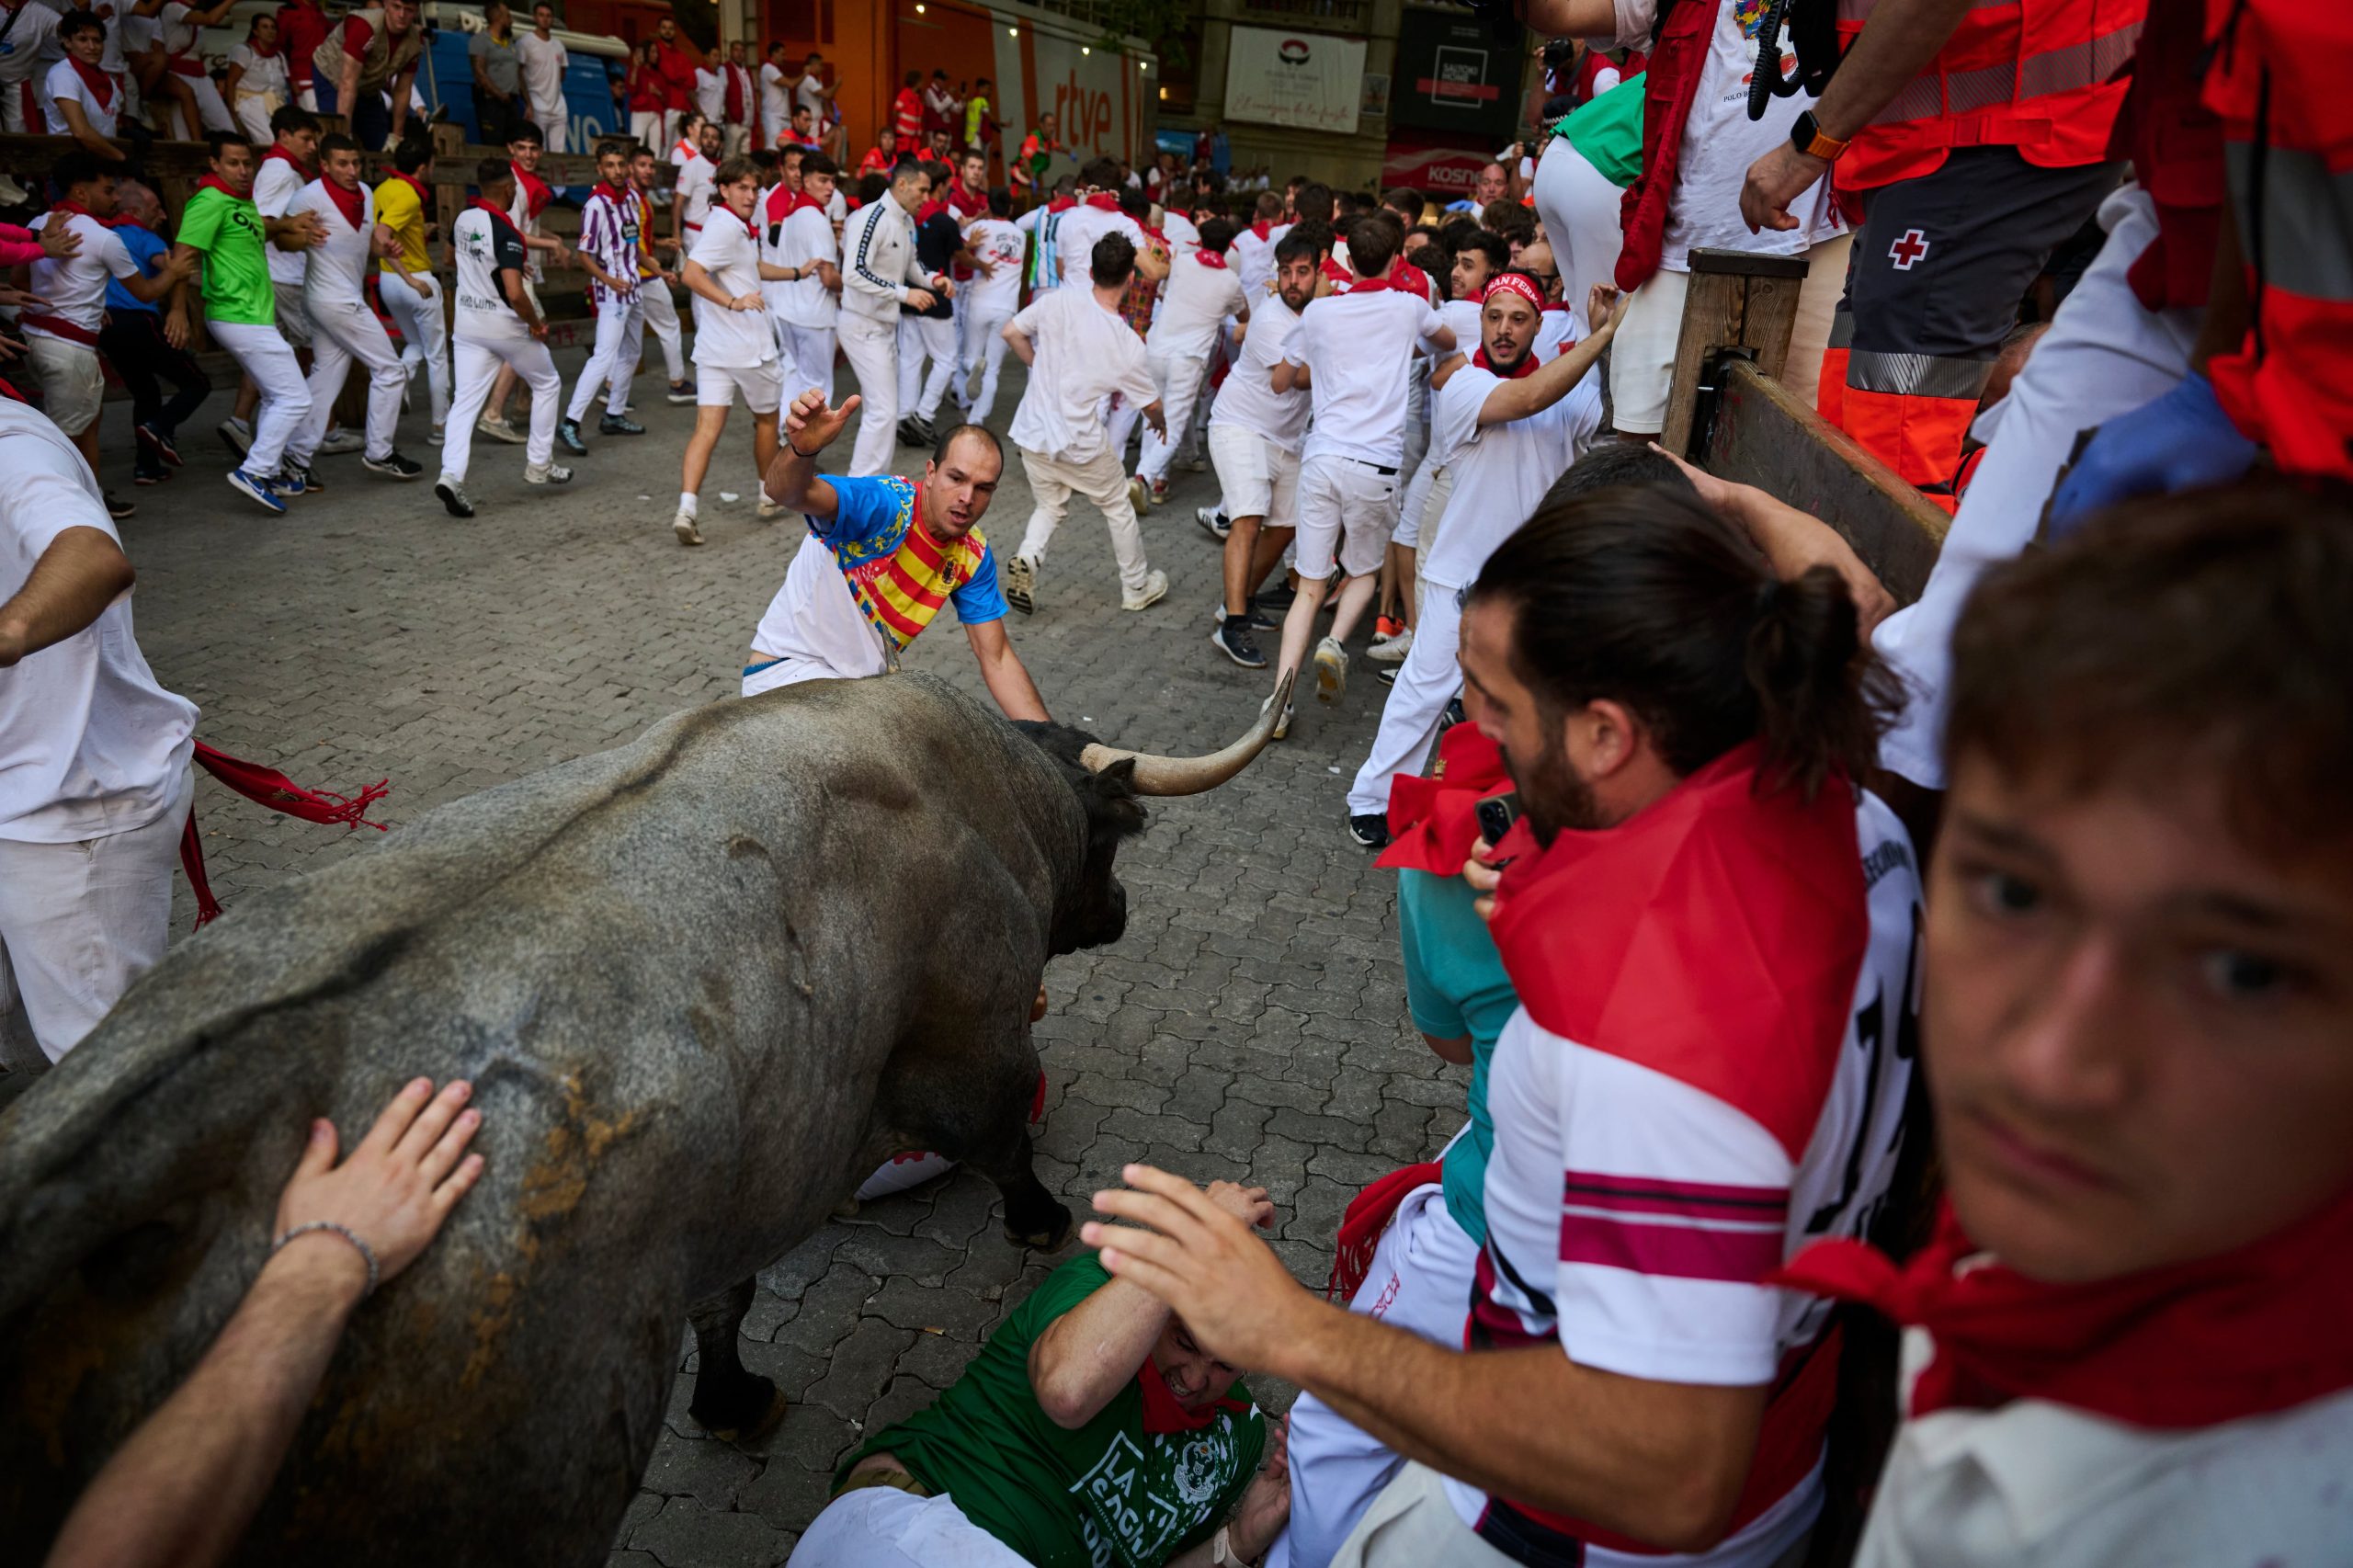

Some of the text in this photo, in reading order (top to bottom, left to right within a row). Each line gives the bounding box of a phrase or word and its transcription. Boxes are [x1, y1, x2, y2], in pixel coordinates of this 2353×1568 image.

[1055, 68, 1112, 156] rtve
[1723, 92, 1743, 102] POLO
[1487, 276, 1511, 291] SAN
[1104, 1450, 1135, 1498] LA
